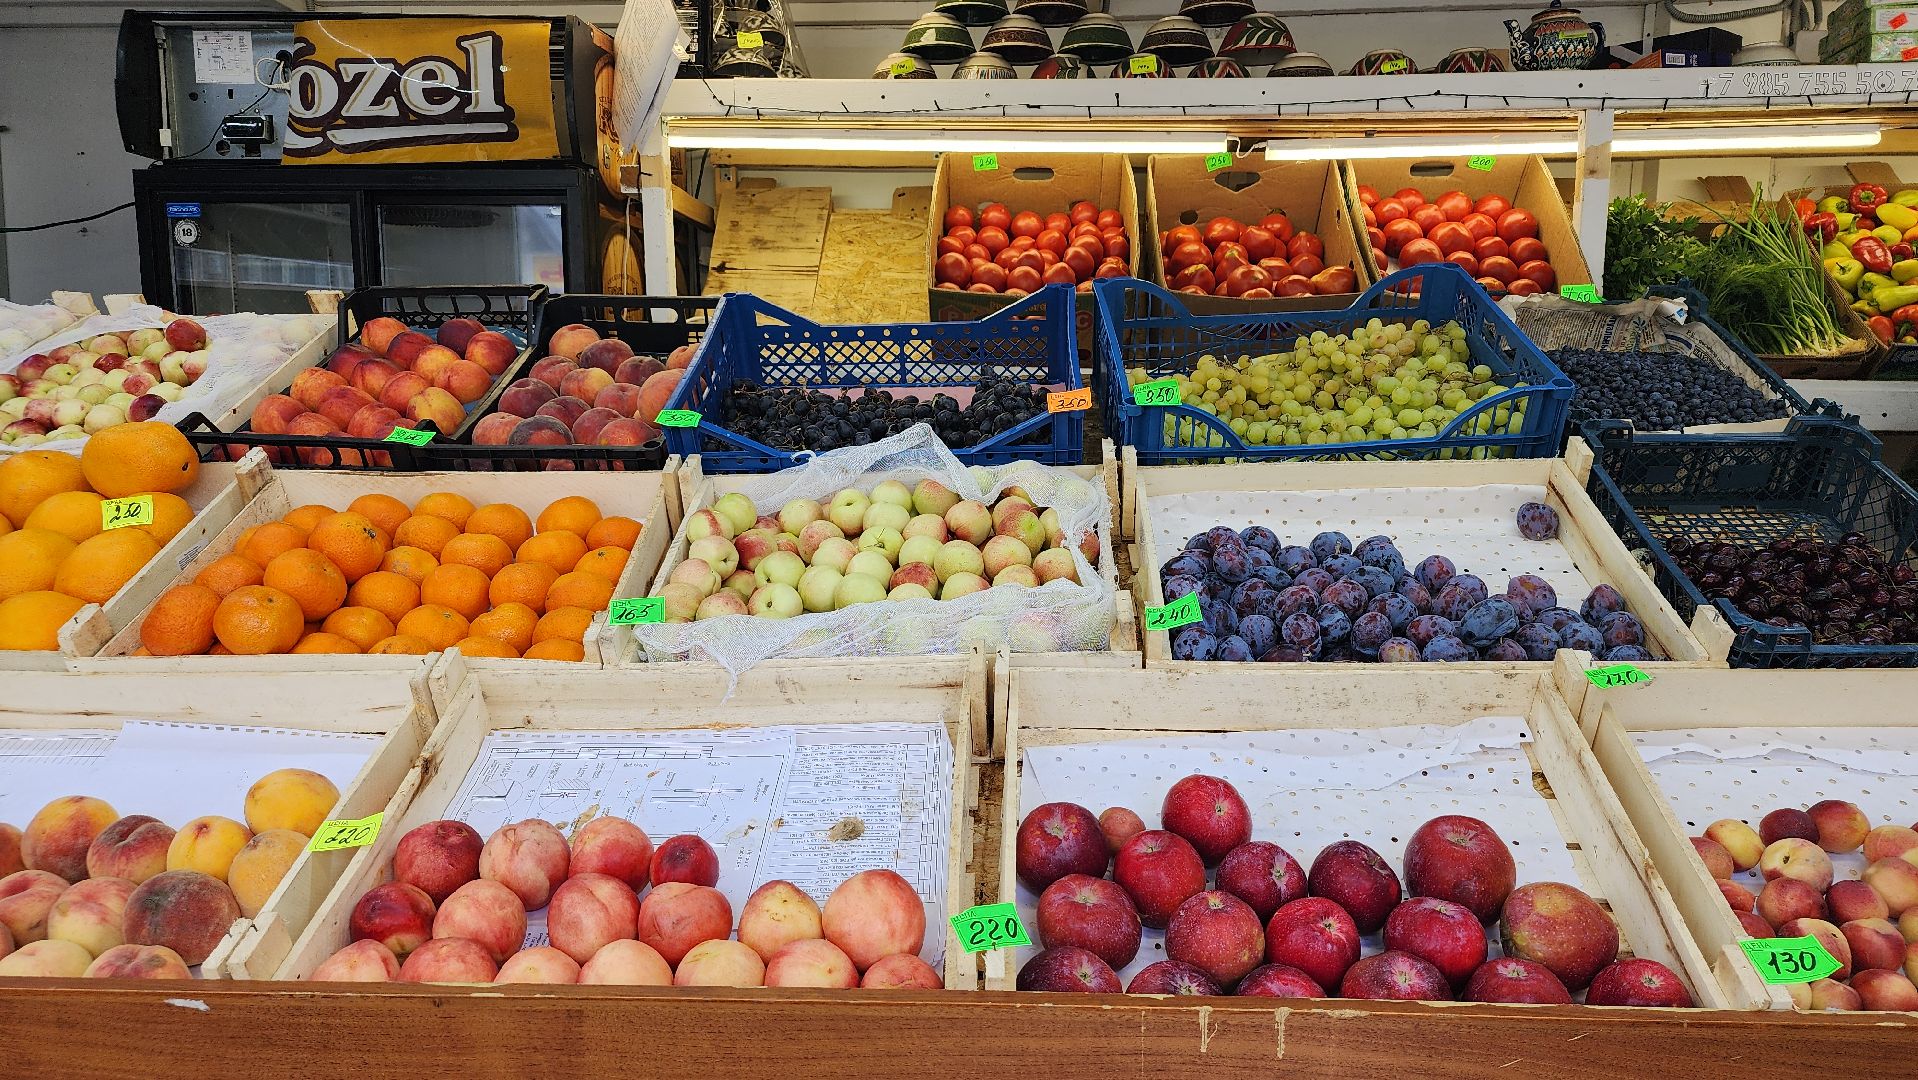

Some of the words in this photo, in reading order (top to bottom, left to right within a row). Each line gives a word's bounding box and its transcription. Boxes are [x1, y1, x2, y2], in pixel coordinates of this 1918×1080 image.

[290, 35, 506, 121] ozel
[1743, 72, 1789, 95] 985
[1799, 71, 1846, 95] 755
[1856, 70, 1895, 94] 50
[1472, 156, 1490, 166] 200
[181, 227, 193, 238] 18
[1056, 397, 1087, 409] 350
[109, 502, 142, 523] 250
[614, 604, 656, 620] 165
[1151, 605, 1190, 625] 240
[1606, 670, 1638, 686] 130
[324, 826, 371, 844] 220
[952, 911, 977, 922] ЦЕНА
[969, 917, 1018, 945] 220
[1743, 941, 1772, 950] ЦЕНА
[1768, 951, 1816, 974] 130
